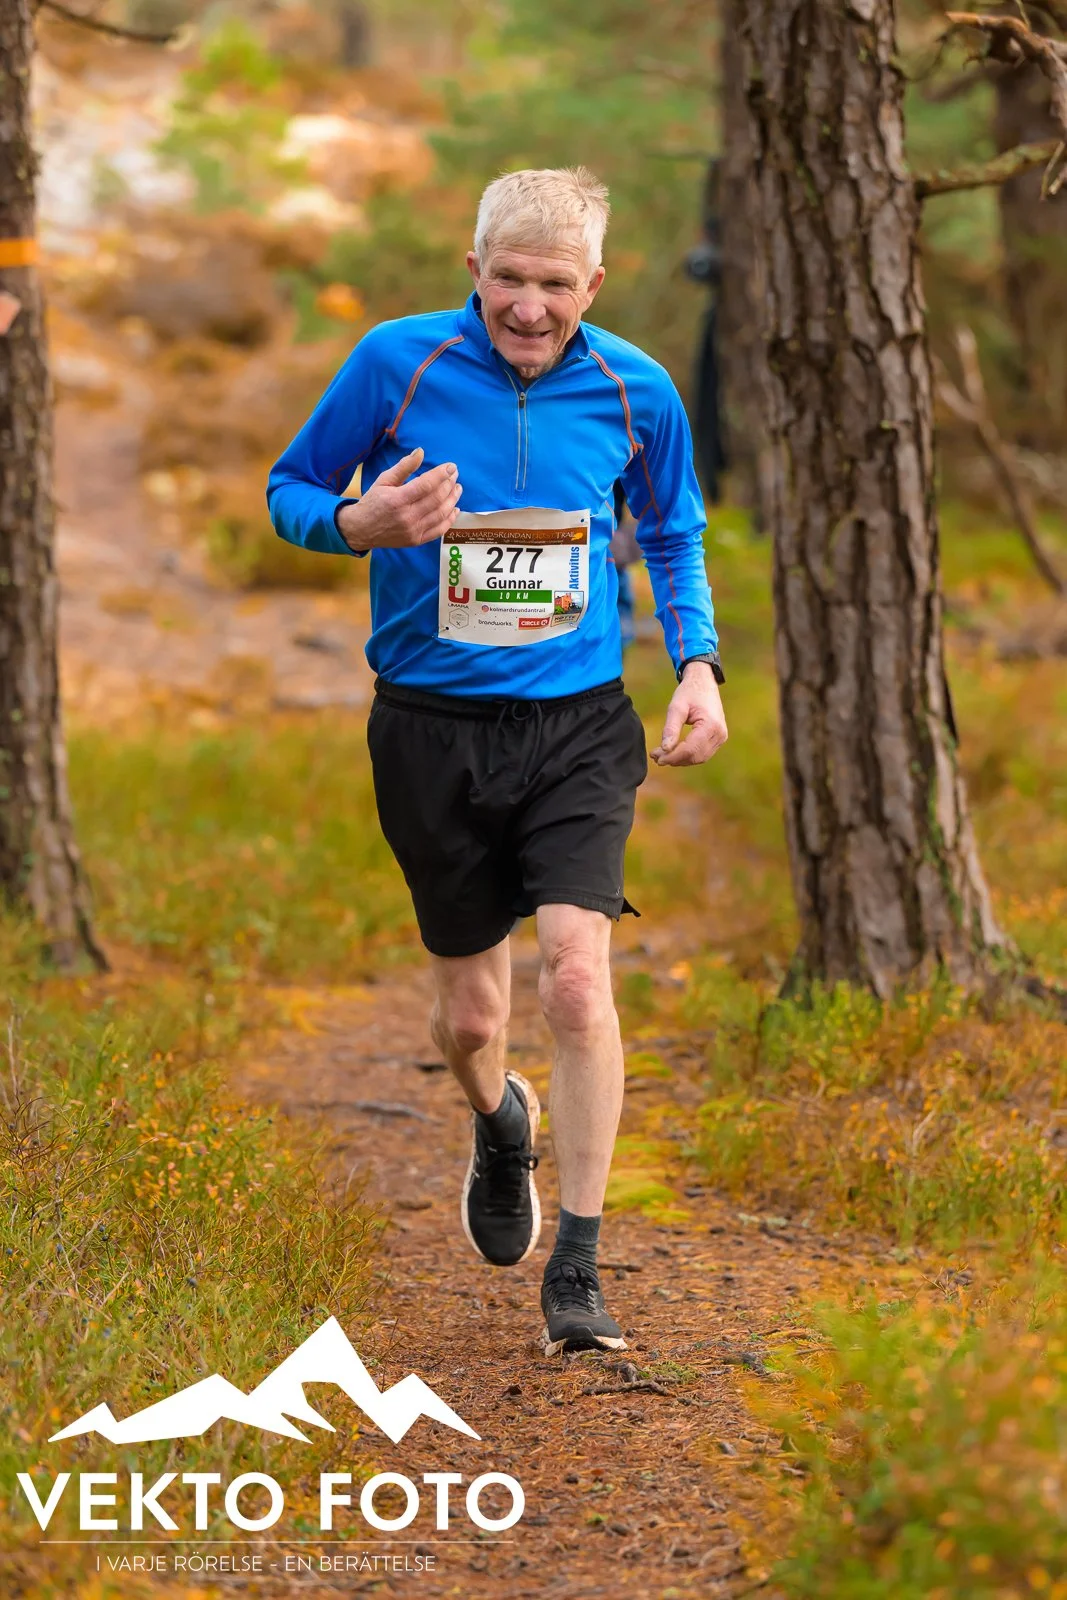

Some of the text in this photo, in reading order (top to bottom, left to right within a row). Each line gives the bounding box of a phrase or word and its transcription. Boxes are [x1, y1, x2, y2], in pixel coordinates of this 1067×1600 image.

[448, 545, 462, 587] coop
[486, 546, 544, 574] 277
[568, 546, 580, 590] Aktivitus
[486, 577, 543, 590] Gunnar
[499, 592, 529, 600] 10 KM
